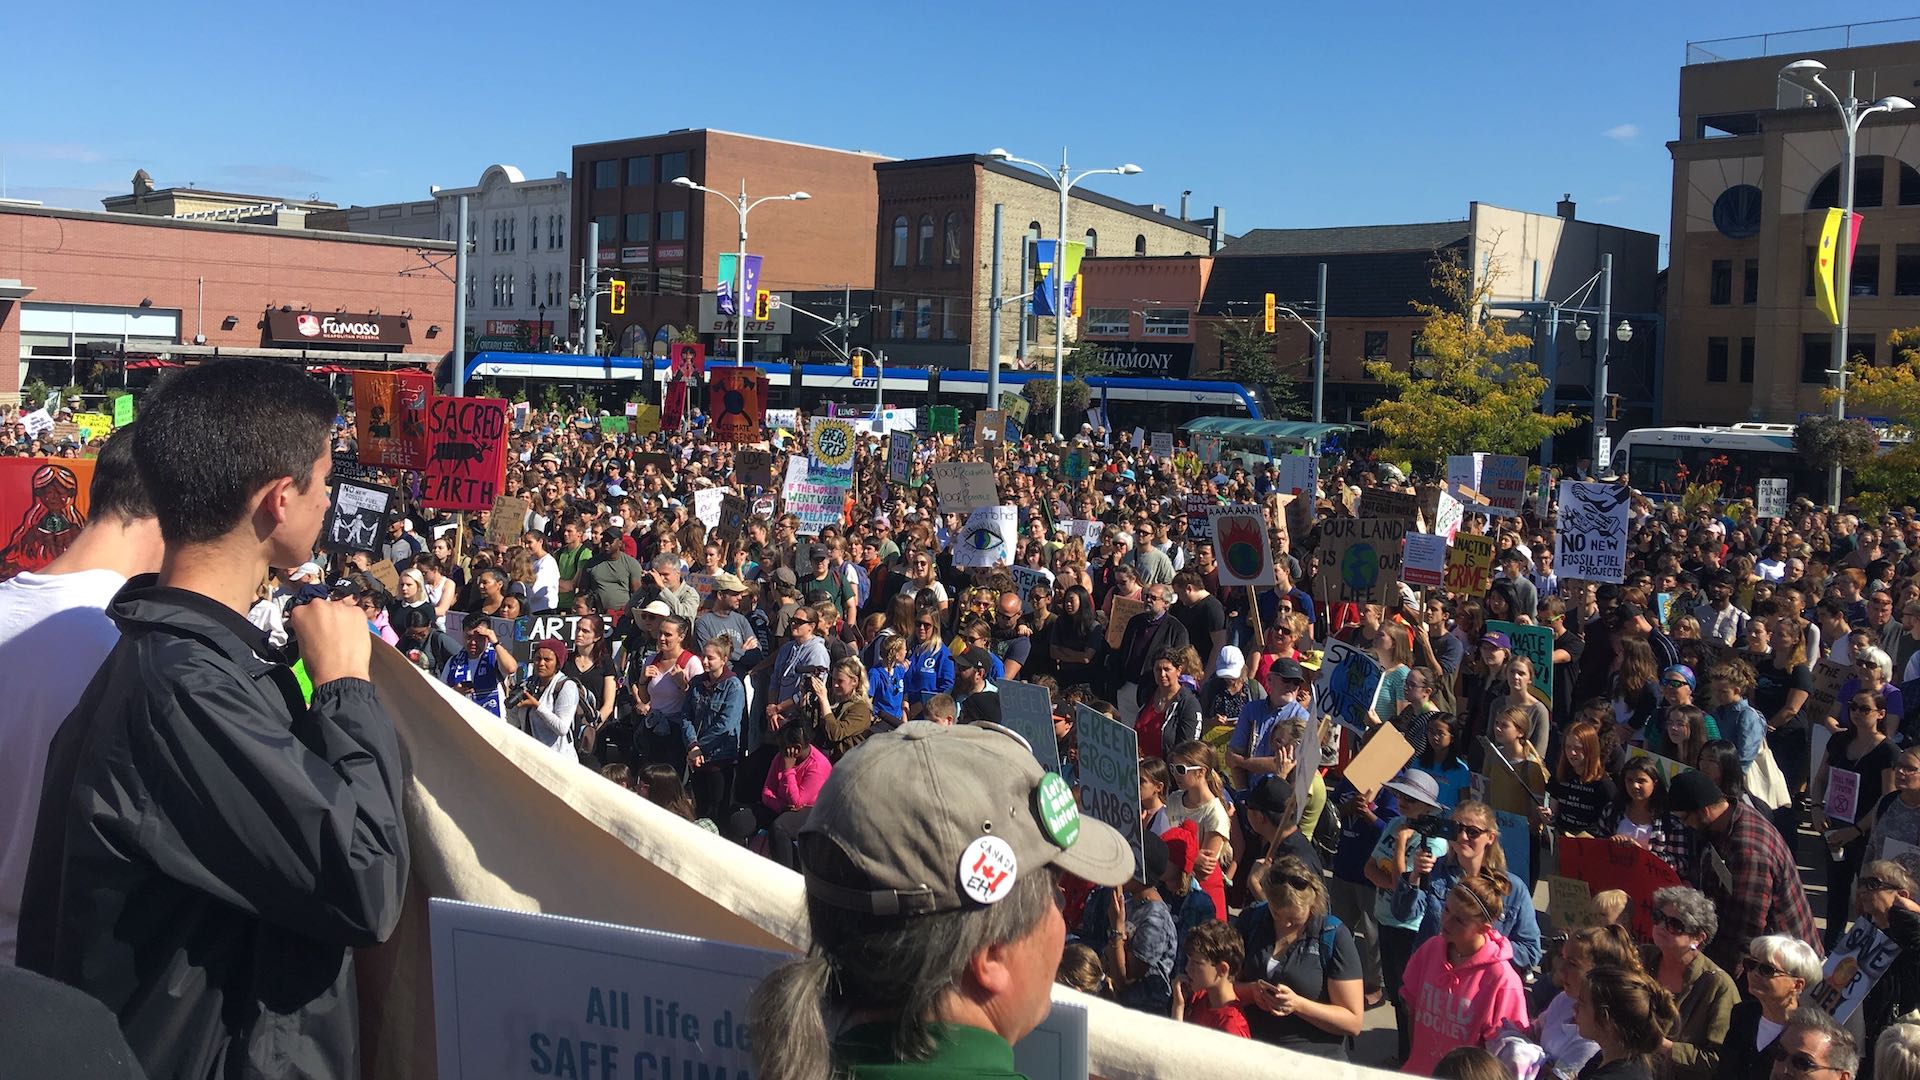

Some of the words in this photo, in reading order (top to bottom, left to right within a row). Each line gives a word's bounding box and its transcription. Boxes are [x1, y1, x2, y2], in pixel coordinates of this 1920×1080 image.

[1097, 352, 1174, 370] HARMONY
[852, 378, 878, 387] GRT
[429, 400, 505, 440] SACRED
[820, 442, 847, 457] FREE
[380, 452, 412, 466] FREE
[342, 484, 355, 494] NO
[423, 474, 494, 505] EARTH
[788, 491, 816, 502] WENT
[797, 483, 813, 493] THE
[813, 485, 839, 496] WORLD
[1761, 487, 1787, 496] PLANET
[796, 502, 824, 513] WOULD
[1323, 519, 1355, 539] OUR
[1361, 520, 1403, 541] LAND
[1561, 532, 1587, 555] NO
[1590, 539, 1620, 552] NEW
[1322, 550, 1336, 567] IS
[1464, 553, 1476, 567] IS
[1561, 553, 1597, 568] FOSSIL
[1597, 554, 1621, 568] FUEL
[1448, 563, 1488, 593] CRIME
[1578, 565, 1623, 578] PROJECTS
[1511, 631, 1547, 653] MATE
[1078, 709, 1137, 760] GREEN
[1078, 741, 1138, 801] GROWS
[979, 840, 1016, 874] CANADA
[585, 986, 630, 1031] All
[643, 994, 701, 1043] life
[529, 1031, 619, 1080] SAFE
